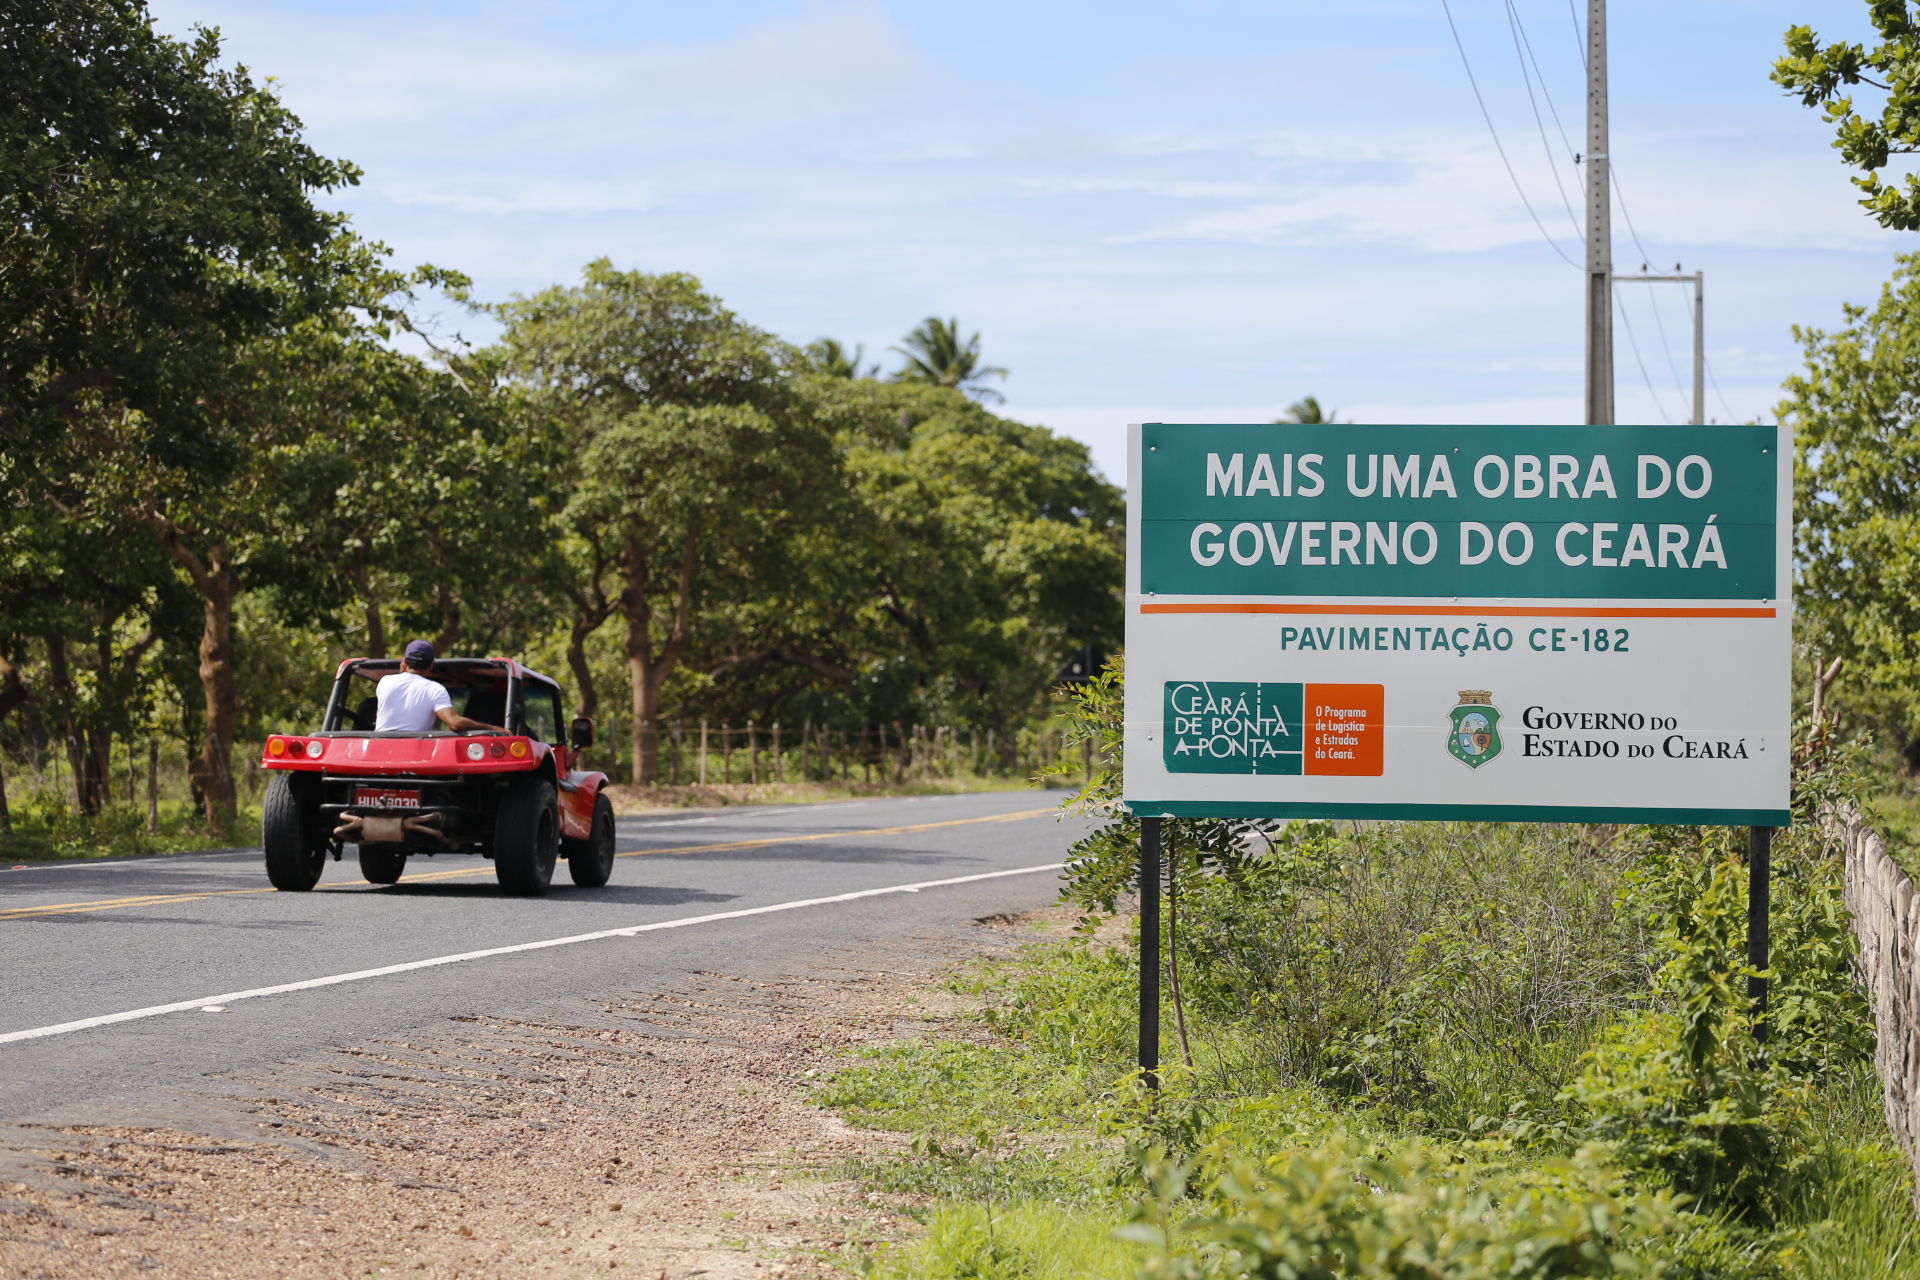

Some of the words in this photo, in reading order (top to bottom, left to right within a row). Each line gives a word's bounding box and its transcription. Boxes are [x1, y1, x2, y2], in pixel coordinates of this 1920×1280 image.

[1206, 453, 1325, 498] MAIS
[1346, 454, 1459, 499] UMA
[1473, 454, 1618, 499] OBRA
[1637, 454, 1713, 499] DO
[1190, 521, 1438, 567] GOVERNO
[1459, 521, 1534, 566] DO
[1555, 513, 1728, 570] CEARÁ
[1281, 622, 1514, 658] PAVIMENTAÇÃO
[1528, 627, 1630, 653] CE-182
[1171, 682, 1250, 716] CEARÁ
[1315, 705, 1322, 717] O
[1324, 706, 1367, 719] Programa
[1175, 716, 1202, 736] DE
[1211, 706, 1290, 737] PONTA
[1315, 719, 1326, 731] de
[1328, 720, 1365, 733] Logística
[1173, 736, 1191, 757] A
[1198, 734, 1277, 759] PONTA
[1315, 736, 1321, 745] e
[1323, 733, 1359, 746] Estradas
[1315, 747, 1326, 759] do
[1328, 747, 1356, 760] Ceará.
